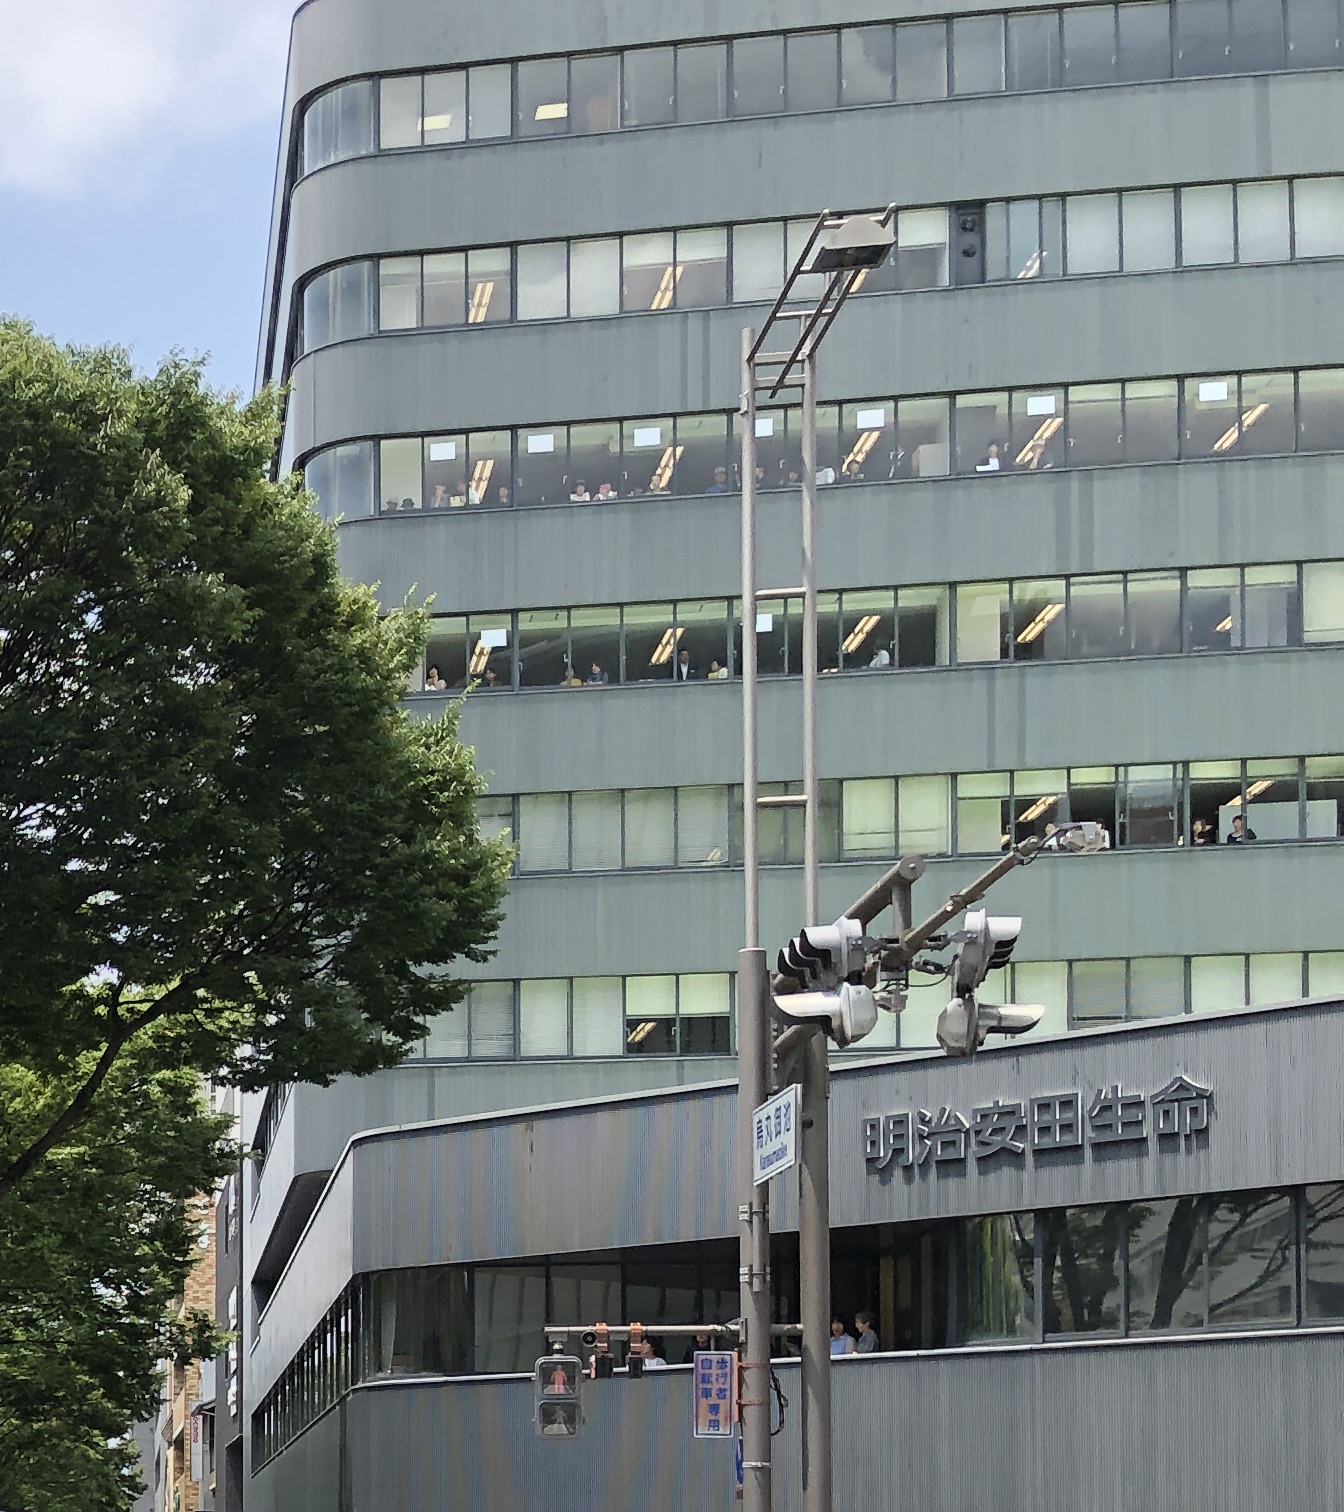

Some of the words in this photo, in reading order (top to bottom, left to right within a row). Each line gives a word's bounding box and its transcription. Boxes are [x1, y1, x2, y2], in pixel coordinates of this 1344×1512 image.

[862, 1074, 1212, 1169] 明治安田生命
